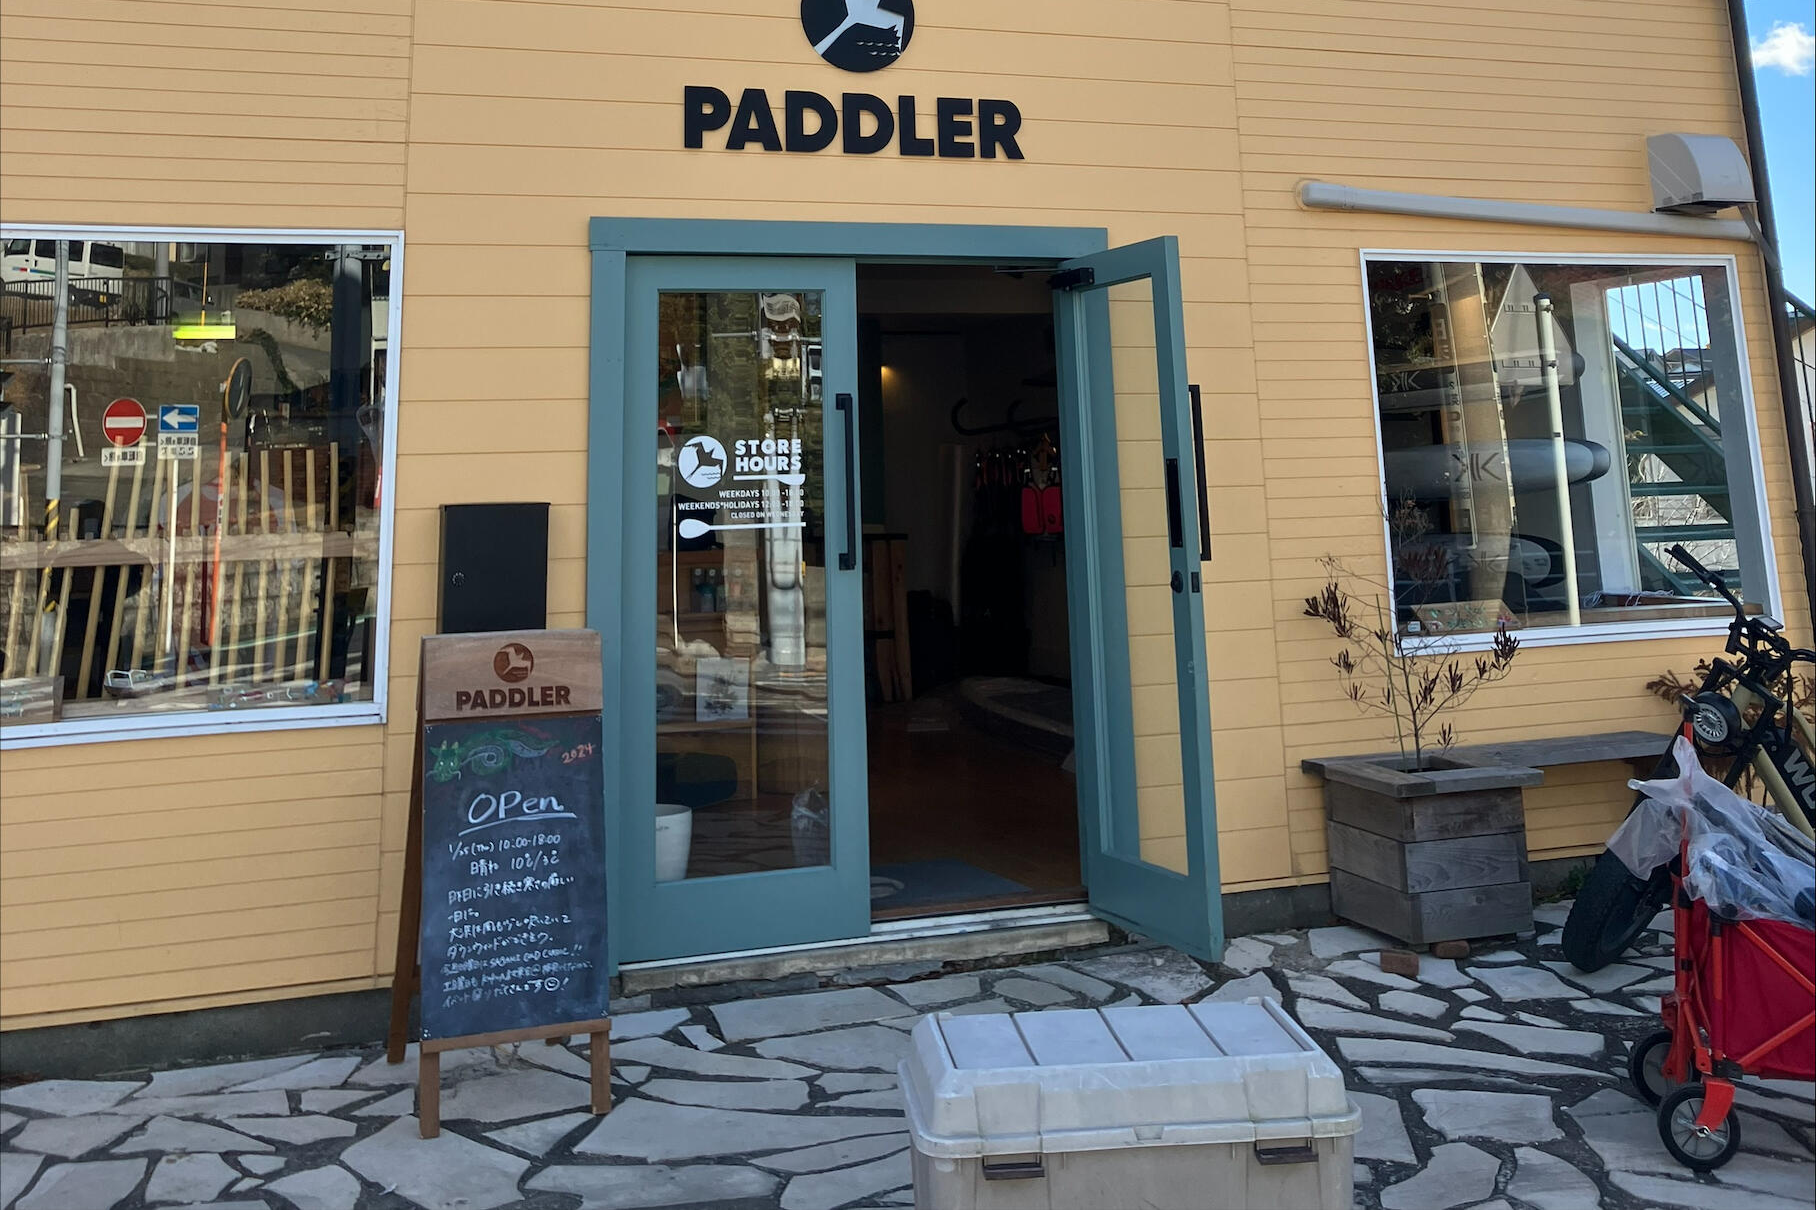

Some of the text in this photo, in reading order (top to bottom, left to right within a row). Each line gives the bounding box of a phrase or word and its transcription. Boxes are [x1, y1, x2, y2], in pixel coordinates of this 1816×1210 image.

[684, 85, 1025, 159] PADDLER
[735, 438, 802, 456] STORE
[735, 456, 802, 473] HOURS
[719, 489, 760, 499] WEEKDAYS
[731, 511, 755, 519] CLOSED
[456, 685, 572, 711] PADDLER
[561, 742, 596, 764] 2024
